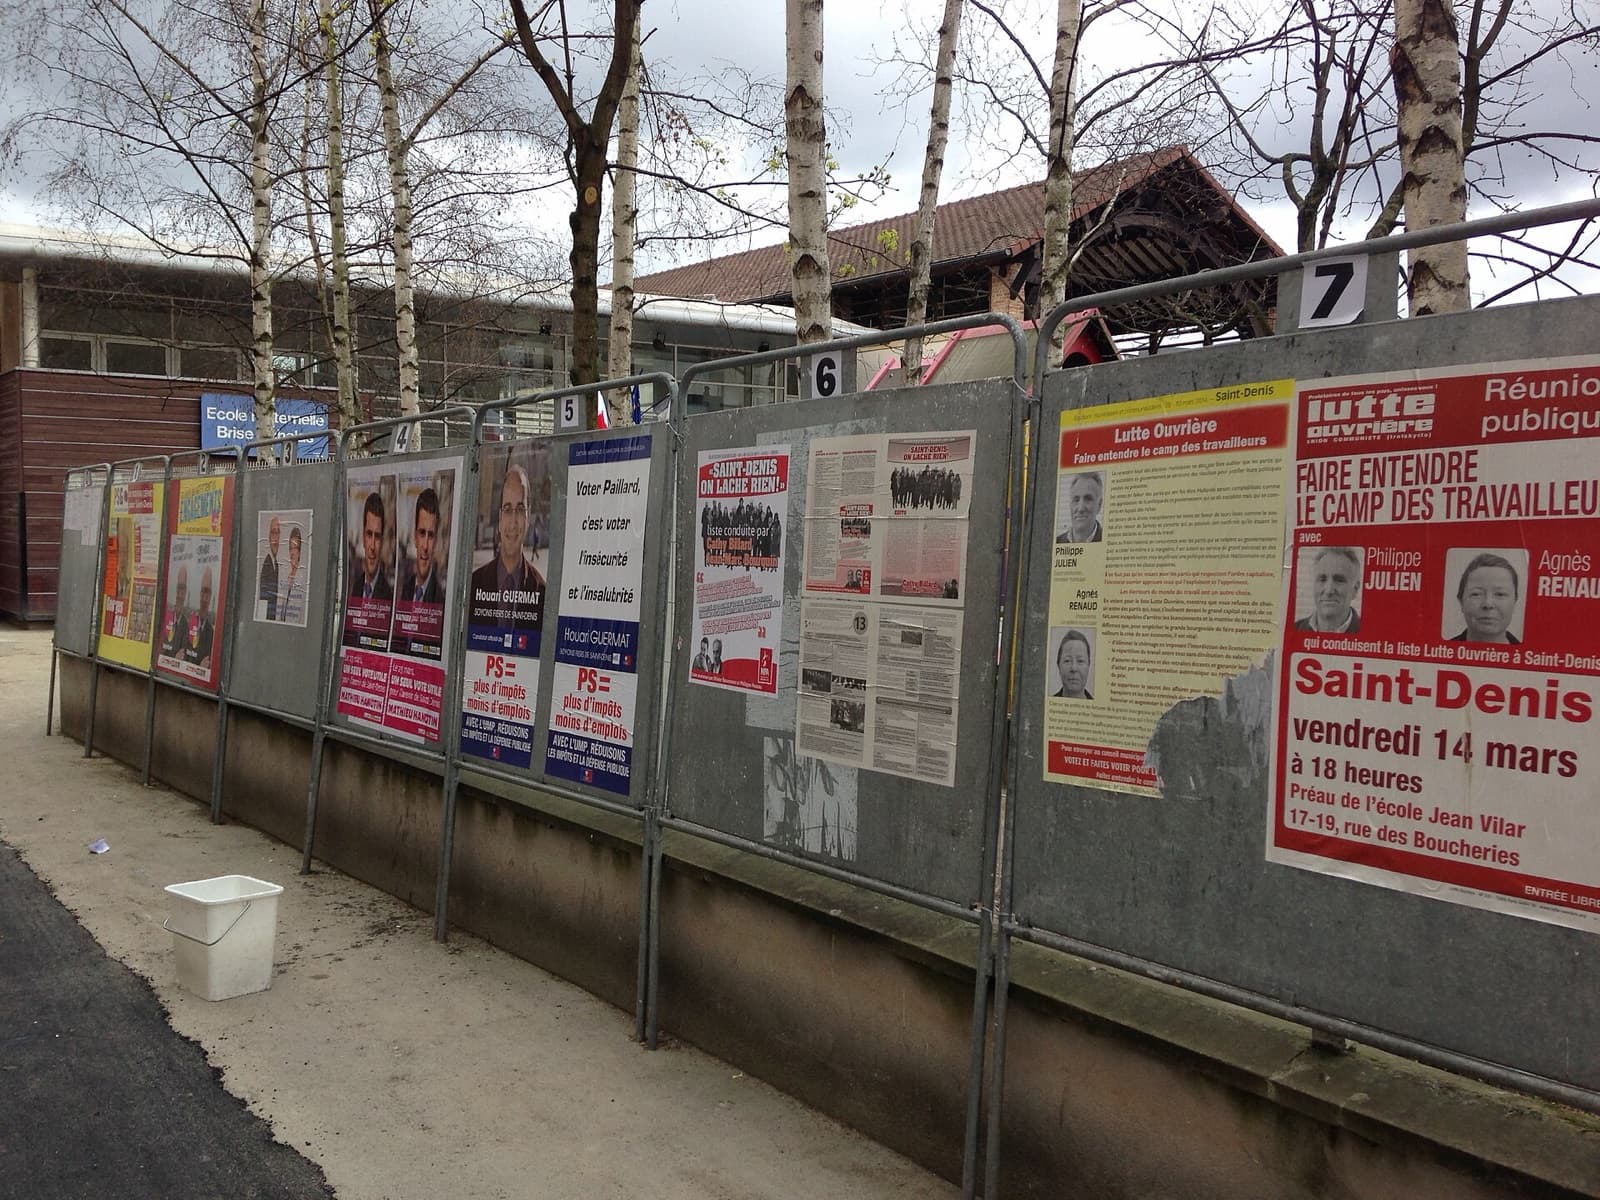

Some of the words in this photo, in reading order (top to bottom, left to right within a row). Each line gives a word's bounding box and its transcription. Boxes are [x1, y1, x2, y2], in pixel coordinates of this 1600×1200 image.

[1310, 263, 1354, 319] 7
[816, 357, 836, 396] 6
[1484, 374, 1600, 402] Réunio
[1216, 384, 1274, 402] Saint-Denis
[206, 407, 248, 422] Ecole
[564, 399, 574, 422] 5
[1308, 393, 1436, 422] lutte
[216, 426, 254, 440] Brise
[1114, 427, 1150, 444] Lutte
[1154, 418, 1217, 439] Ouvrière
[1307, 418, 1434, 438] ouvrière
[1480, 406, 1600, 438] publiqu
[397, 426, 408, 448] 4
[285, 441, 292, 464] 3
[1074, 452, 1097, 464] Faire
[1098, 448, 1140, 462] entendre
[1141, 447, 1151, 458] le
[1152, 444, 1179, 458] camp
[1181, 440, 1200, 453] des
[1202, 435, 1268, 450] travailleurs
[200, 453, 206, 473] 2
[1297, 460, 1353, 494] FAIRE
[1359, 450, 1478, 489] ENTENDRE
[576, 481, 601, 496] Voter
[602, 478, 640, 496] Paillard,
[700, 480, 714, 494] ON
[716, 478, 749, 494] LACHE
[1297, 494, 1316, 526] LE
[1322, 490, 1384, 525] CAMP
[1392, 487, 1434, 522] DES
[1442, 480, 1598, 520] TRAVAILLEU
[582, 516, 602, 532] c'est
[606, 517, 630, 530] voter
[707, 524, 723, 536] liste
[724, 523, 756, 536] conduite
[756, 527, 769, 538] par
[1299, 532, 1322, 543] avec
[578, 550, 628, 567] l'insécurité
[1054, 558, 1078, 568] JULIEN
[1055, 546, 1085, 558] Philippe
[1366, 547, 1422, 570] Philippe
[1538, 550, 1592, 576] Agnès
[1364, 572, 1422, 592] JULIEN
[1538, 576, 1600, 599] RENAU
[476, 588, 502, 602] Houari
[502, 590, 540, 604] GUERMAT
[568, 586, 578, 600] et
[580, 584, 634, 604] l'insalubrité
[1069, 600, 1098, 611] RENAUD
[1076, 588, 1099, 600] Agnès
[854, 617, 866, 630] 13
[564, 628, 590, 644] Houari
[590, 630, 630, 648] GUERMAT
[1304, 637, 1321, 650] qui
[1322, 638, 1380, 653] conduisent
[1384, 642, 1394, 654] la
[1397, 642, 1420, 656] liste
[1424, 644, 1454, 658] Lutte
[1457, 646, 1510, 663] Ouvrière
[1513, 649, 1521, 664] à
[1524, 651, 1600, 669] Saint-Denis
[474, 679, 490, 696] plus
[492, 681, 526, 701] d'impôts
[1294, 658, 1592, 723] Saint-Denis
[467, 697, 488, 712] moins
[492, 700, 530, 721] d'emplois
[563, 694, 582, 710] plus
[584, 695, 622, 719] d'impôts
[466, 716, 480, 728] AVEC
[498, 720, 528, 740] RÉDUISONS
[555, 714, 580, 730] moins
[583, 716, 628, 741] d'emplois
[552, 734, 568, 748] AVEC
[570, 737, 589, 754] L'UMP,
[590, 741, 626, 762] RÉDUISONS
[1294, 718, 1421, 757] vendredi
[1434, 729, 1473, 764] 14
[1486, 741, 1578, 778] mars
[548, 748, 556, 758] LES
[556, 748, 573, 762] IMPÔTS
[573, 752, 578, 764] ET
[579, 754, 586, 766] LA
[586, 753, 606, 770] DÉPENSE
[606, 760, 630, 778] PUBLIQUE
[1064, 756, 1082, 766] VOTEZ
[1292, 753, 1303, 774] à
[1311, 756, 1338, 780] 18
[1344, 761, 1423, 794] heures
[1290, 783, 1336, 806] Préau
[1341, 792, 1360, 810] de
[1366, 796, 1423, 820] l'école
[1428, 806, 1473, 830] Jean
[1480, 814, 1526, 838] Vilar
[1290, 808, 1340, 836] 17-19,
[1344, 819, 1372, 838] rue
[1377, 824, 1408, 846] des
[1414, 831, 1520, 867] Boucheries
[1524, 884, 1568, 902] ENTRÉE
[1570, 894, 1600, 908] LIBRE
